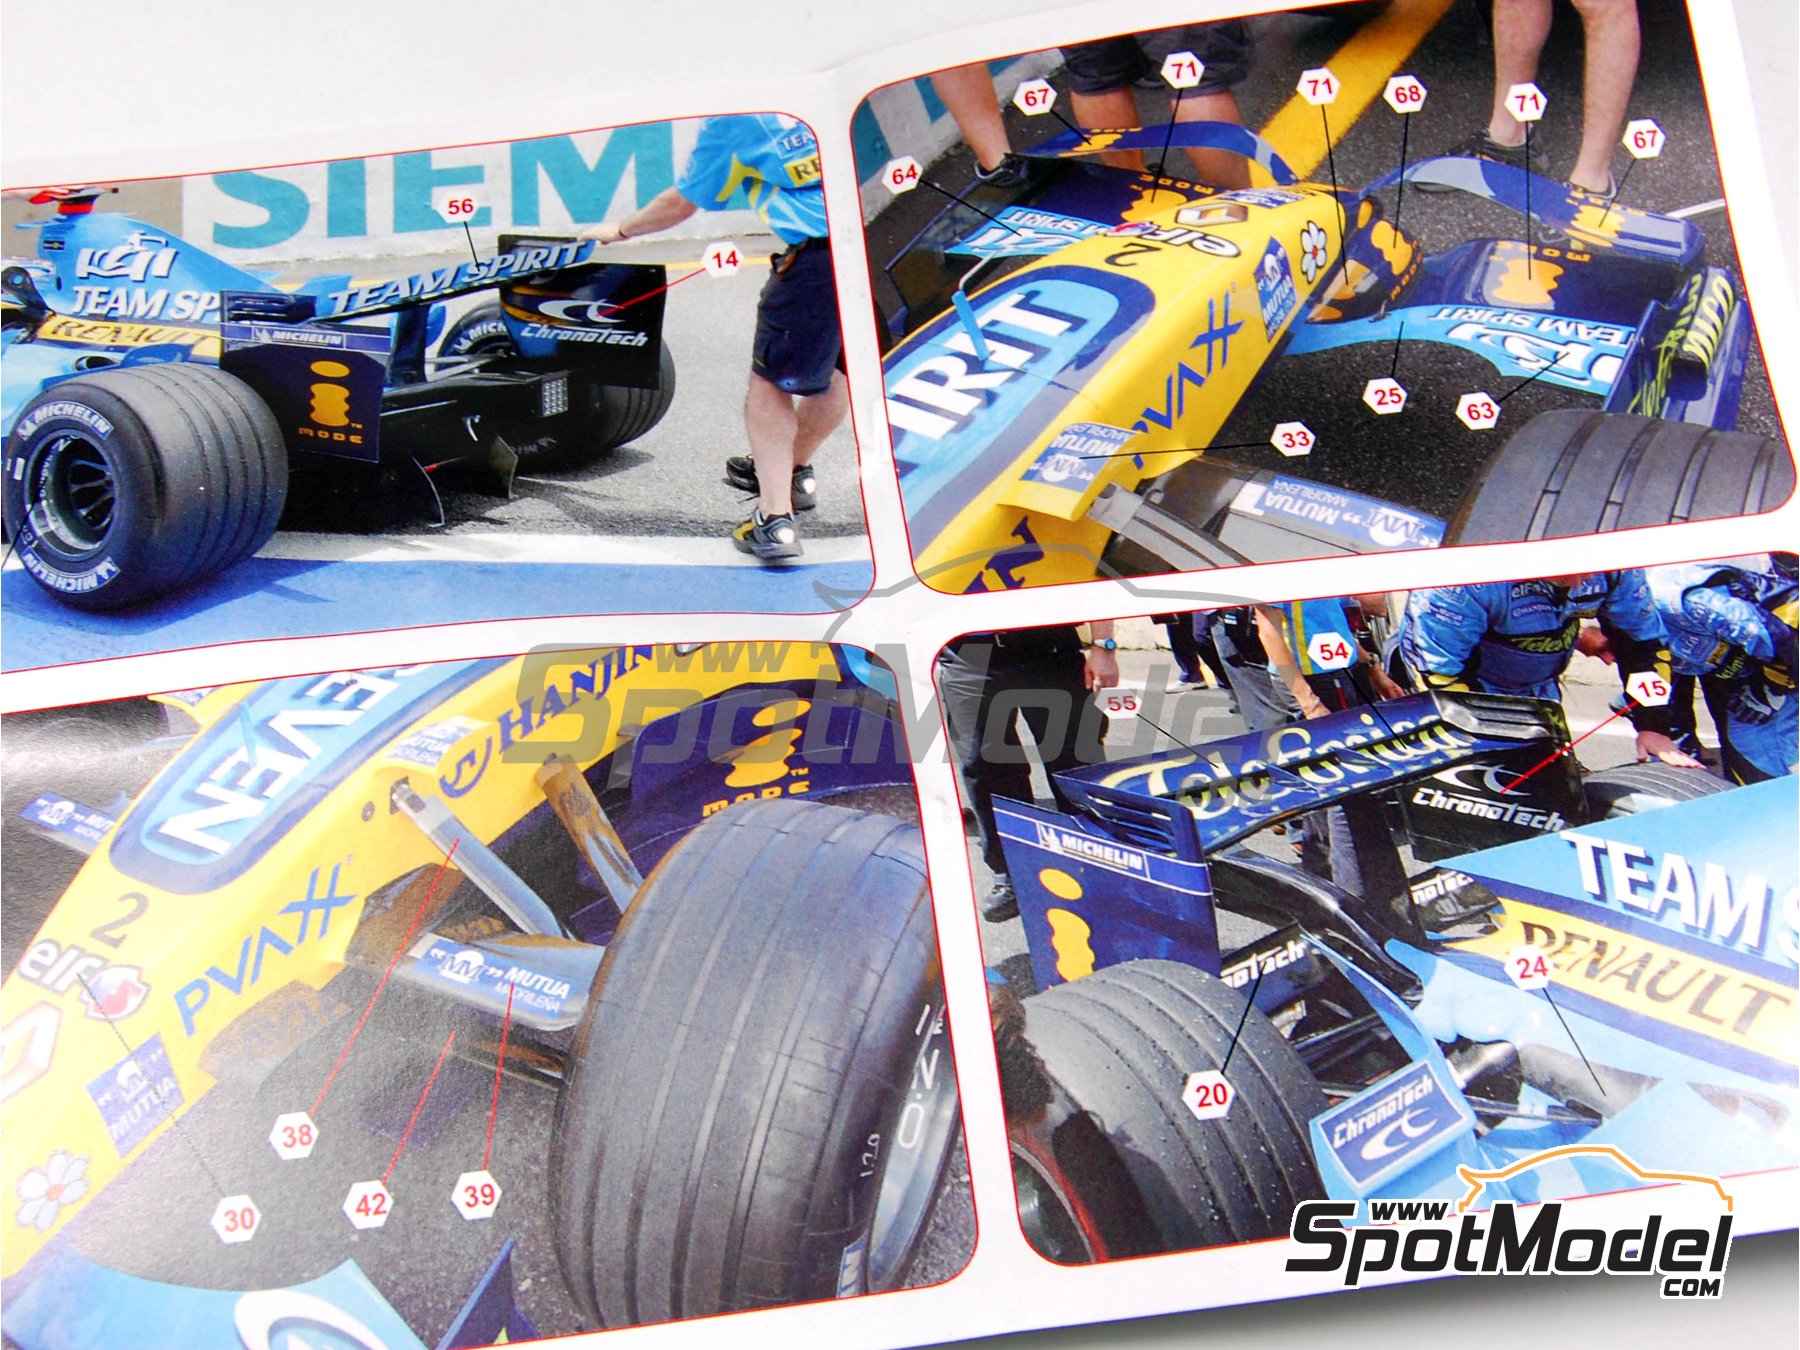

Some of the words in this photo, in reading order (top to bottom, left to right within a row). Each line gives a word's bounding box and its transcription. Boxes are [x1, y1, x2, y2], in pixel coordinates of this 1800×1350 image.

[1171, 61, 1197, 80] 71
[1024, 88, 1050, 107] 67
[1308, 79, 1334, 97] 71
[1395, 86, 1421, 104] 68
[1515, 94, 1541, 112] 71
[1634, 130, 1660, 149] 67
[891, 164, 919, 185] 64
[211, 122, 775, 250] SIEM
[448, 198, 475, 215] 56
[711, 250, 739, 269] 14
[1104, 242, 1162, 267] 2
[328, 264, 462, 313] TEAM
[464, 240, 590, 283] SPIRIT
[72, 285, 169, 319] TEAM
[168, 290, 221, 323] SP
[1428, 307, 1535, 328] SPIRIT
[272, 329, 343, 346] MICHELIN
[1375, 387, 1402, 406] 25
[33, 402, 110, 435] MICHELIN
[1467, 402, 1495, 421] 63
[1282, 430, 1311, 448] 33
[1263, 491, 1342, 527] MUTUA
[1320, 642, 1349, 661] 54
[1637, 680, 1668, 698] 15
[1107, 696, 1137, 712] 55
[157, 664, 430, 857] EVEN
[1060, 832, 1144, 872] MICHELIN
[1559, 831, 1770, 952] TEAM
[90, 891, 149, 949] 2
[1517, 957, 1547, 980] 24
[504, 966, 571, 1000] MUTUA
[1195, 1084, 1228, 1107] 20
[282, 1123, 313, 1149] 38
[355, 1192, 388, 1218] 42
[464, 1183, 496, 1210] 39
[224, 1207, 255, 1231] 30
